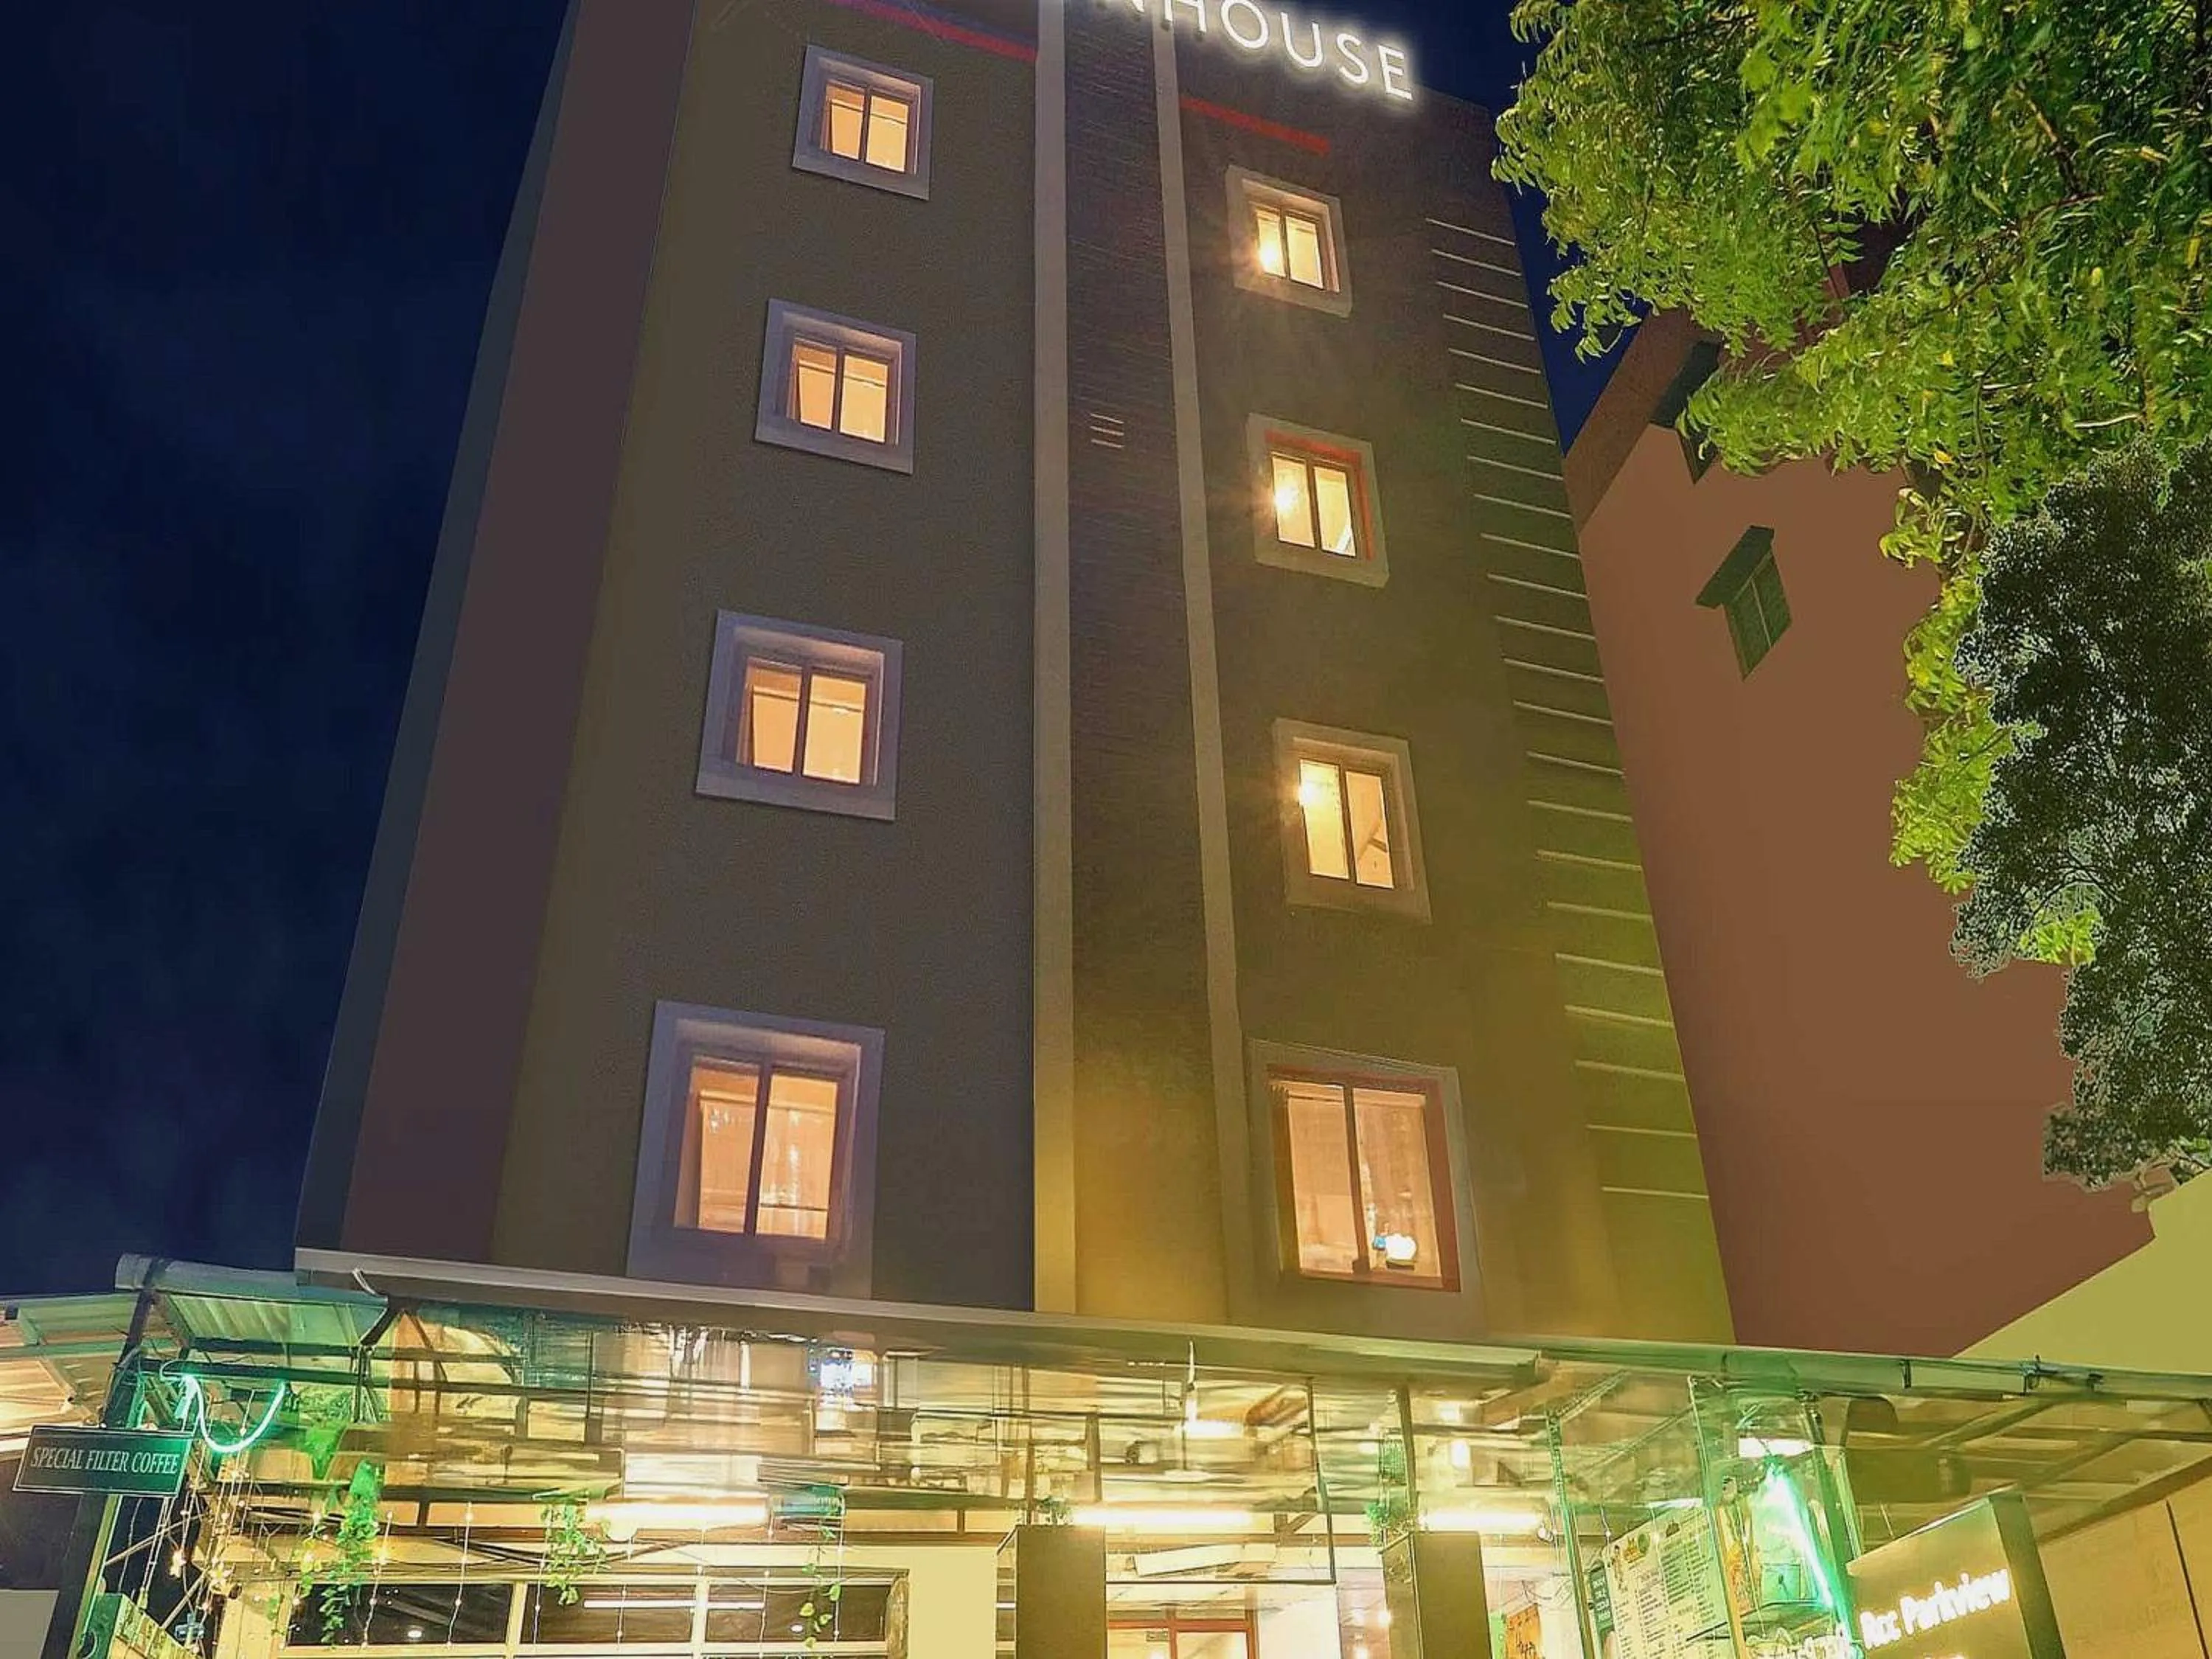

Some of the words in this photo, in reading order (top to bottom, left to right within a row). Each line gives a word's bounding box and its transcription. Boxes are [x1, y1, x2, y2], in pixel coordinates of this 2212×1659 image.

[1132, 0, 1413, 101] HOUSE
[32, 1447, 85, 1469] SPECIAL
[86, 1450, 129, 1472] FILTER
[131, 1453, 179, 1474] COFFEE
[1899, 1568, 2011, 1635] Parkview
